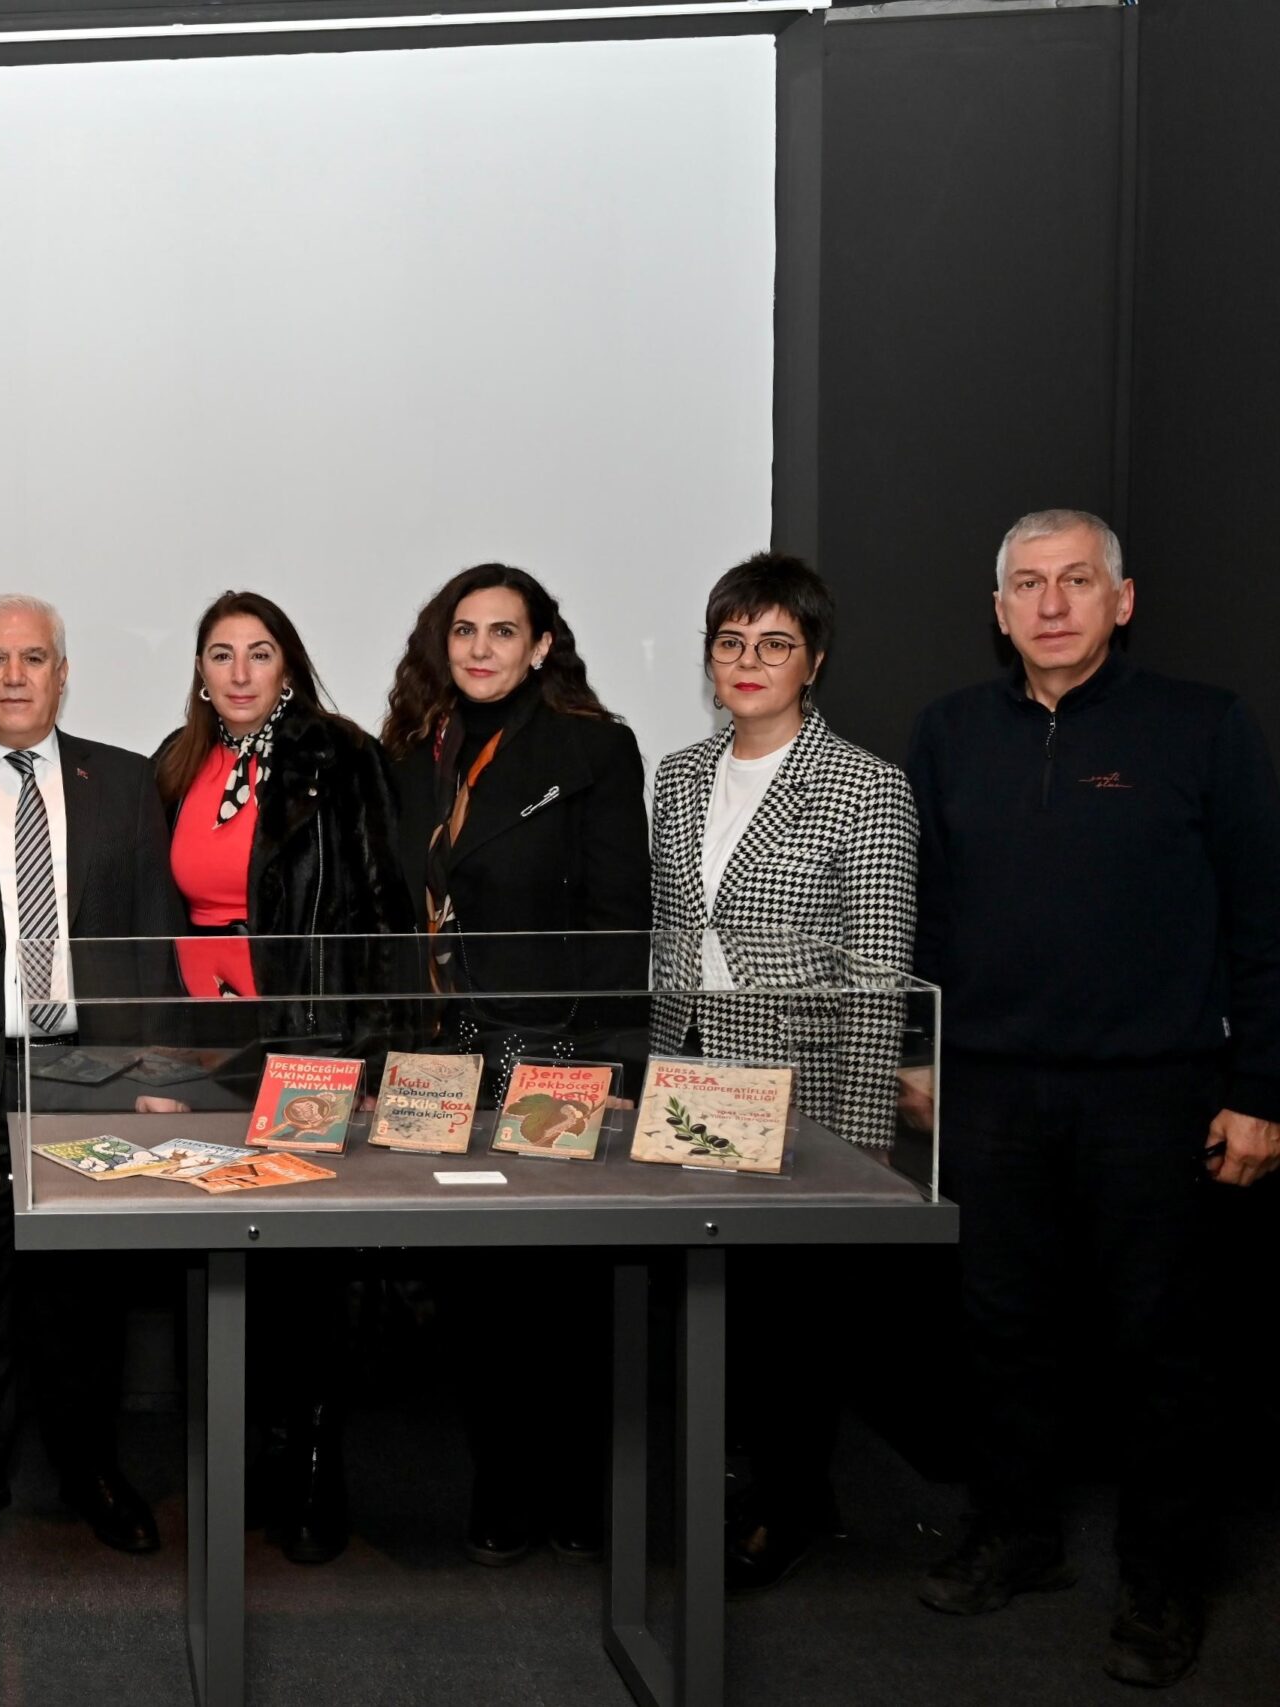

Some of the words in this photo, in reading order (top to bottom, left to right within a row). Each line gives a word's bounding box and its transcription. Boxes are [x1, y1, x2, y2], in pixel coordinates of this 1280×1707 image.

[268, 1070, 332, 1082] YAKINDAN
[387, 1064, 398, 1086] 1
[398, 1076, 430, 1089] Kutu
[569, 1070, 593, 1080] de
[657, 1066, 696, 1075] BURSA
[282, 1080, 353, 1091] TANIYALIM
[654, 1072, 720, 1088] KOZA
[398, 1087, 463, 1099] Tohumdan
[384, 1094, 409, 1108] 75
[410, 1097, 438, 1110] Kilo
[391, 1107, 430, 1118] almak
[433, 1110, 453, 1120] için
